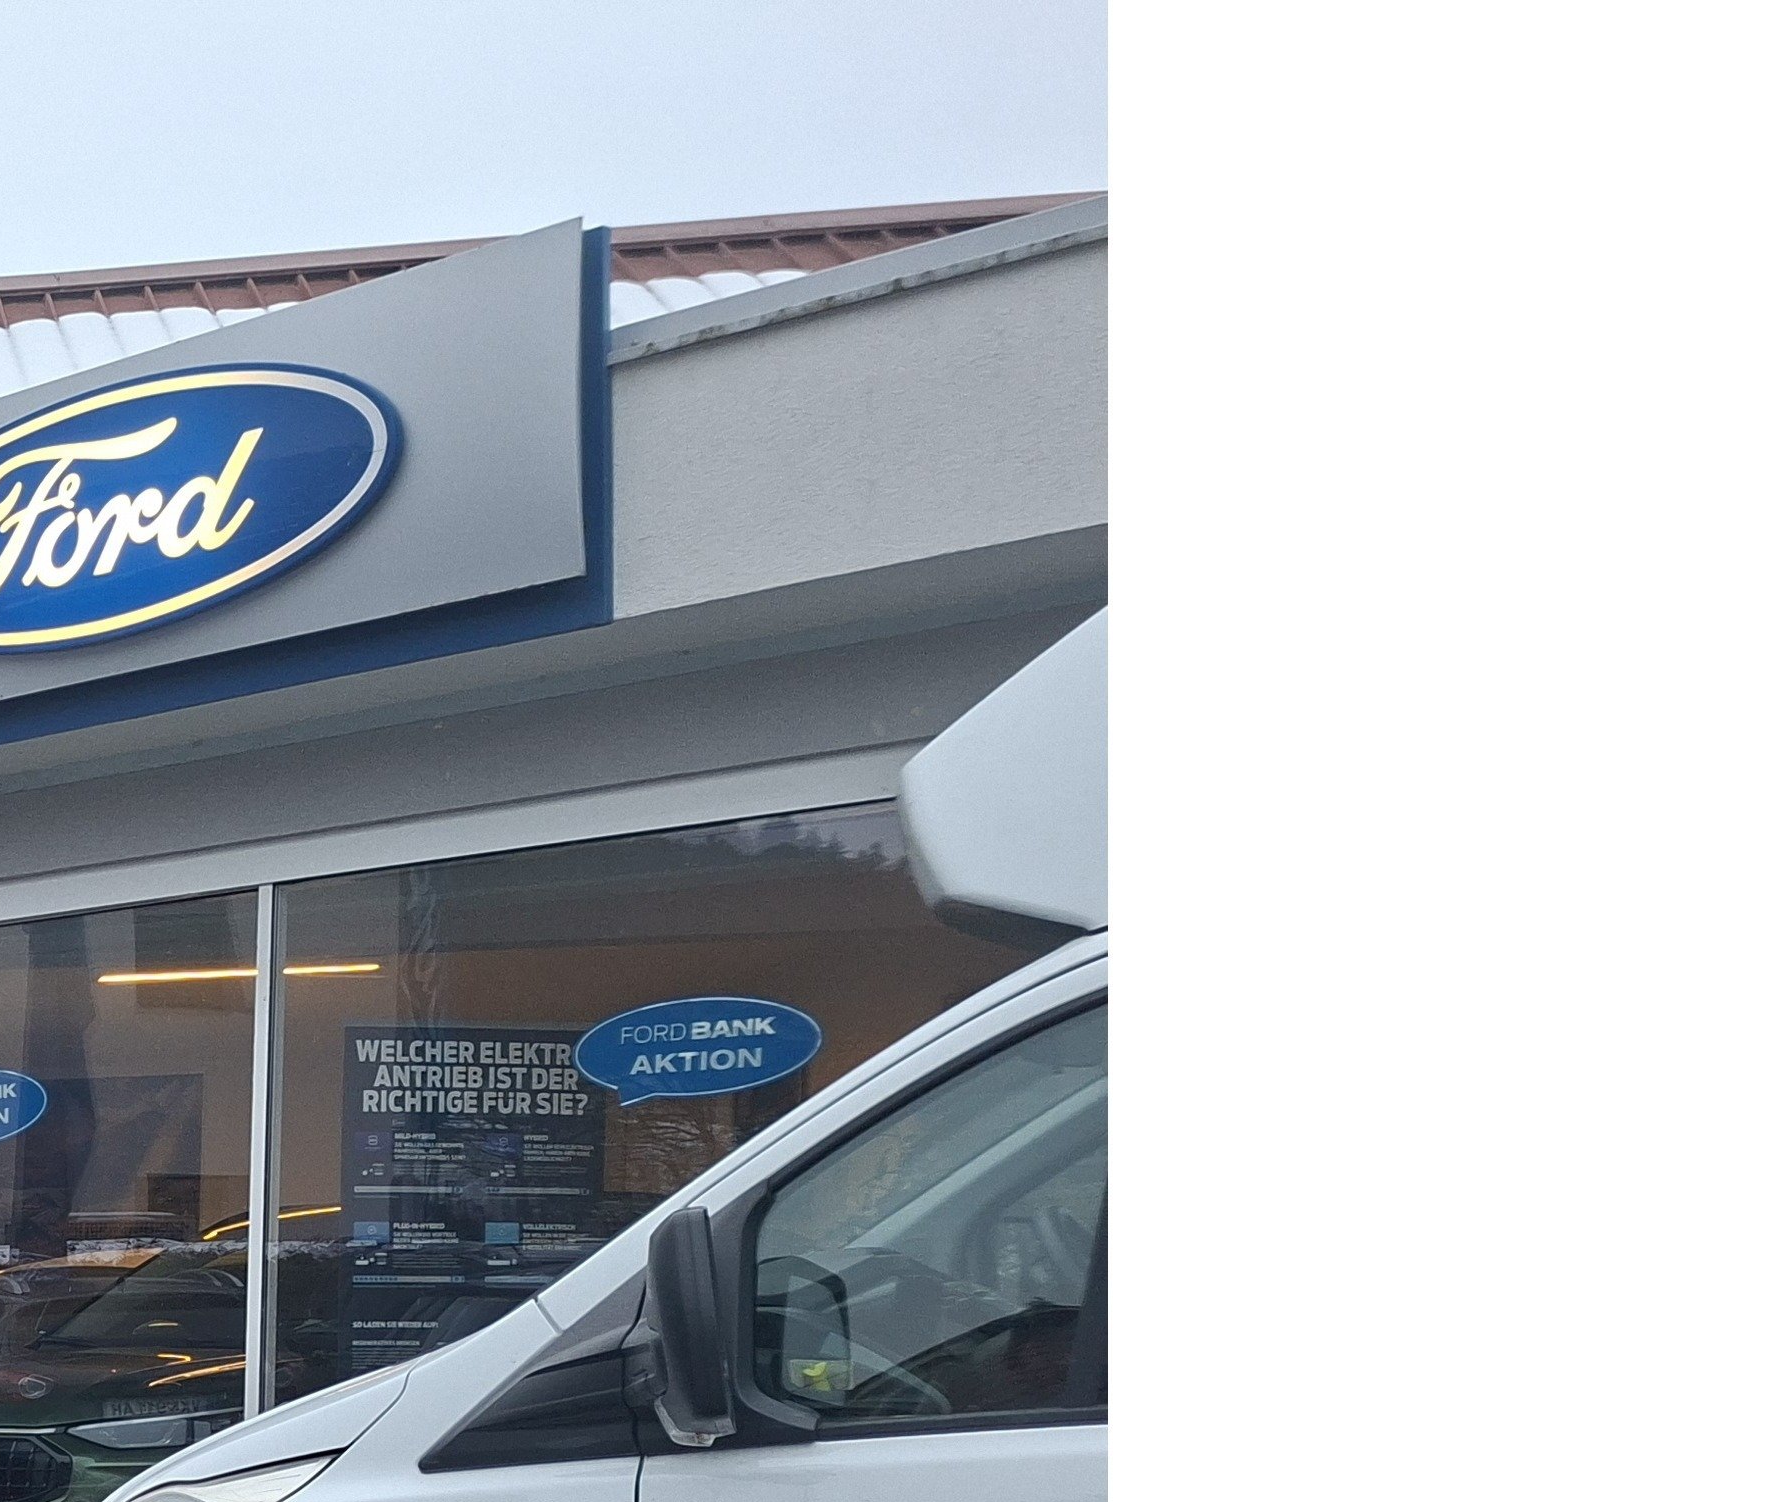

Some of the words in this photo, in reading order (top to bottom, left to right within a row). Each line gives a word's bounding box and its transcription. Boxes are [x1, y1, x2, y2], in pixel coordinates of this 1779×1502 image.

[621, 1022, 687, 1045] FORD
[690, 1016, 776, 1041] BANK
[355, 1039, 475, 1063] WELCHER
[479, 1042, 571, 1065] ELEKTR
[629, 1047, 763, 1076] AKTION
[373, 1064, 483, 1089] ANTRIEB
[489, 1066, 528, 1089] IST
[531, 1068, 579, 1091] DER
[362, 1090, 478, 1114] RICHTIGE
[482, 1091, 532, 1115] FÜR
[535, 1092, 589, 1116] SIE?
